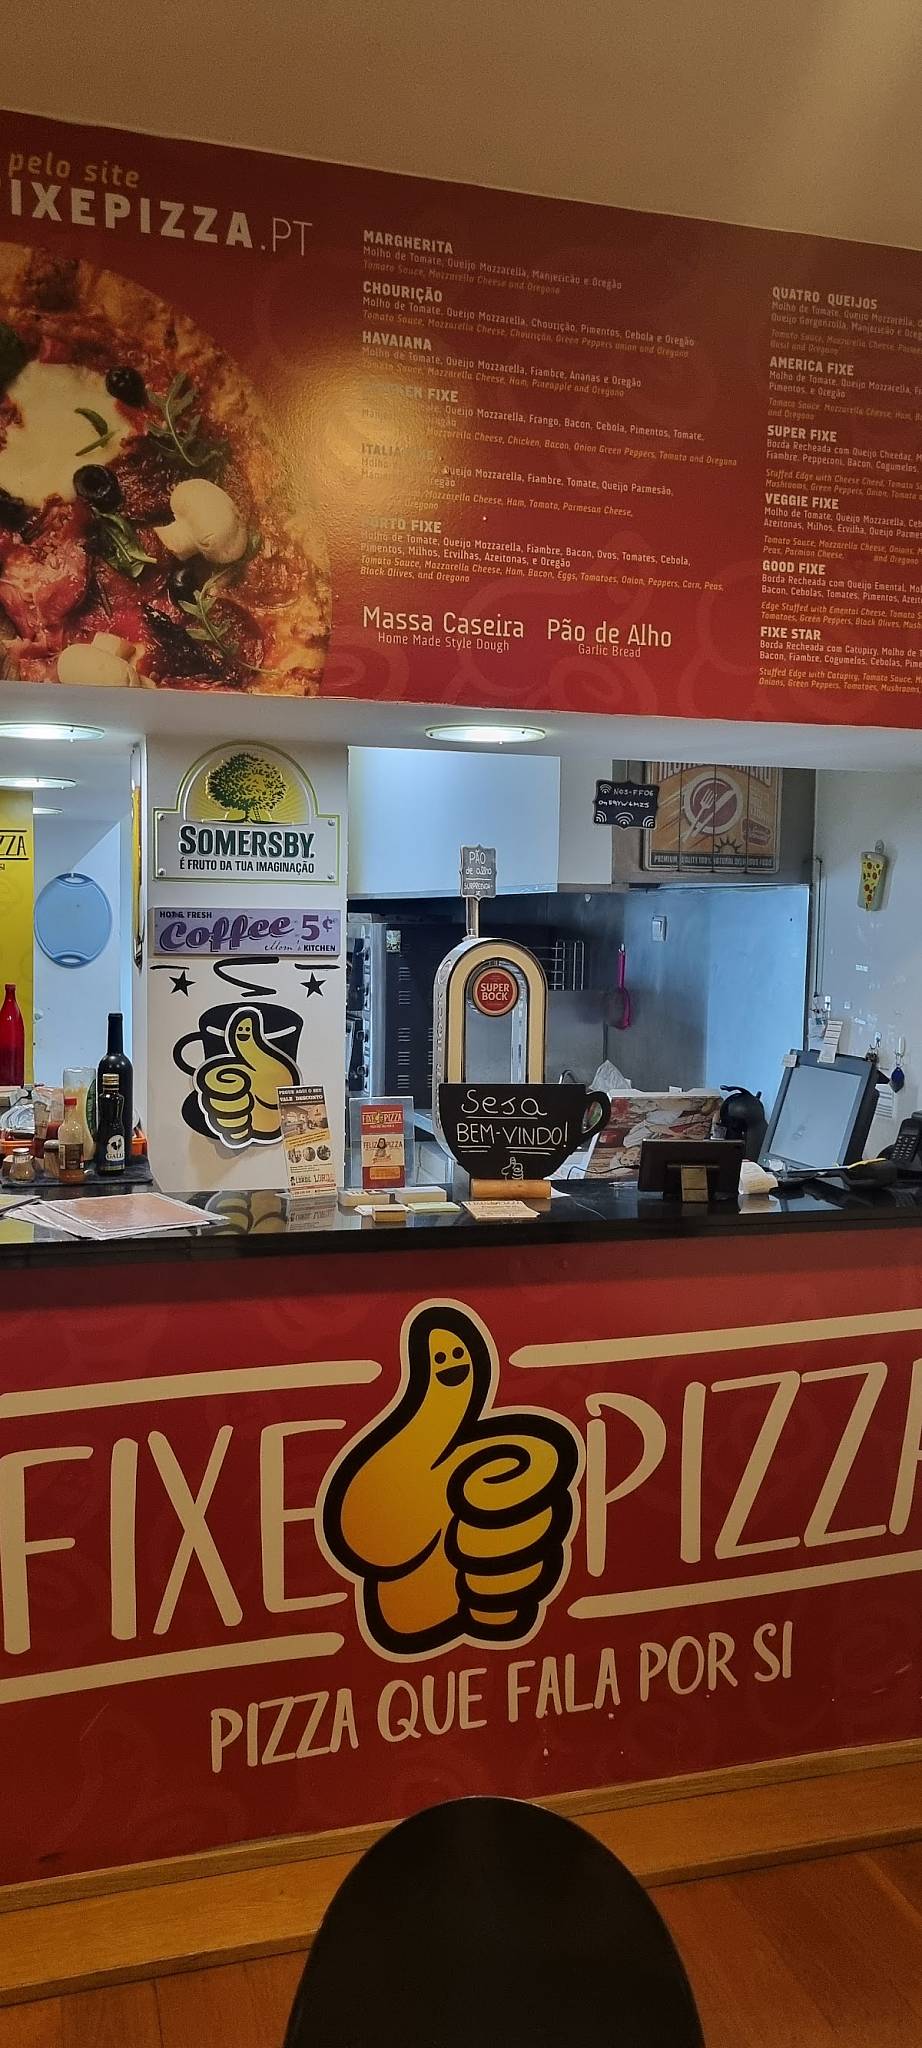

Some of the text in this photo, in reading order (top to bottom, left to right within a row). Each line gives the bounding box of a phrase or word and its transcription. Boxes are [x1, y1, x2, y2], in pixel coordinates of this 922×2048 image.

[9, 151, 139, 188] pelo site
[0, 178, 313, 256] IXEPIZZA.PT
[362, 229, 454, 255] MARGHERITA
[362, 280, 443, 303] CHOURIÇÃO
[772, 285, 878, 311] QUATRO QUEIJOS
[362, 296, 390, 309] Molho
[394, 300, 405, 311] de
[446, 307, 474, 321] Queijo
[624, 329, 654, 341] Cebola
[362, 330, 432, 351] HAVAIANA
[446, 356, 474, 370] Queijo
[477, 359, 528, 375] Mozzarella,
[530, 365, 566, 380] Fiambre,
[569, 370, 600, 383] Ananas
[603, 376, 609, 384] e
[611, 375, 641, 389] Oregão
[768, 355, 854, 376] AMERICA FIXE
[426, 387, 458, 402] FIXE
[445, 404, 473, 419] Queijo
[476, 408, 526, 423] Mozzarella,
[528, 413, 561, 428] Frango,
[564, 417, 593, 430] Bacon,
[630, 424, 670, 438] Pimentos,
[766, 425, 837, 443] SUPER FIXE
[474, 468, 524, 483] Mozzarella,
[527, 473, 564, 487] Fiambre,
[566, 477, 599, 490] Tomate,
[601, 480, 628, 493] Queijo
[630, 483, 673, 497] Parmesão,
[764, 493, 839, 510] VEGGIE FIXE
[410, 518, 442, 533] FIXE
[360, 542, 404, 556] Pimentos,
[408, 546, 440, 559] Milhos,
[443, 549, 482, 562] Ervilhas,
[484, 552, 529, 565] Azeitonas,
[540, 556, 570, 569] Oregão
[390, 532, 402, 542] de
[406, 533, 440, 546] Tomate,
[442, 536, 470, 550] Queijo
[474, 538, 524, 553] Mozzarella,
[526, 543, 563, 556] Fiambre,
[565, 546, 594, 558] Bacon,
[596, 548, 620, 560] Ovos,
[622, 550, 658, 563] Tomates,
[660, 553, 690, 566] Cebola,
[360, 554, 392, 567] Tomato
[394, 557, 422, 570] Sauce,
[424, 559, 470, 572] Mozzarella
[472, 563, 502, 576] Cheese,
[504, 565, 525, 577] Ham,
[527, 567, 554, 580] Bacon,
[556, 569, 578, 582] Eggs,
[648, 576, 680, 589] Peppers,
[360, 566, 470, 585] Black Olives, and Oregano
[762, 560, 826, 575] GOOD FIXE
[363, 605, 524, 638] Massa Caseira
[378, 631, 510, 652] Home Made Style Dough
[547, 617, 672, 648] Pão de Alho
[760, 625, 821, 640] FIXE STAR
[577, 644, 641, 658] Garlic Bread
[759, 639, 783, 649] Borda
[785, 640, 824, 652] Recheada
[826, 645, 842, 653] com
[880, 647, 904, 657] Molho
[906, 648, 916, 657] de
[180, 857, 315, 875] É FRUTO DA TUA IMAGINAÇÃO
[469, 849, 486, 865] PÃO
[465, 866, 473, 875] de
[187, 911, 212, 919] FRESH
[159, 914, 294, 953] Coffee
[303, 944, 336, 952] KITCHEN
[480, 983, 510, 993] SUPER
[481, 991, 509, 1001] BOCK
[461, 1089, 547, 1117] Seja
[384, 1113, 402, 1122] PIZZA
[456, 1121, 569, 1148] BEM-VINDO!
[0, 1419, 348, 1655] FIXE
[211, 1620, 793, 1773] PIZZA QUE FALA POR SI
